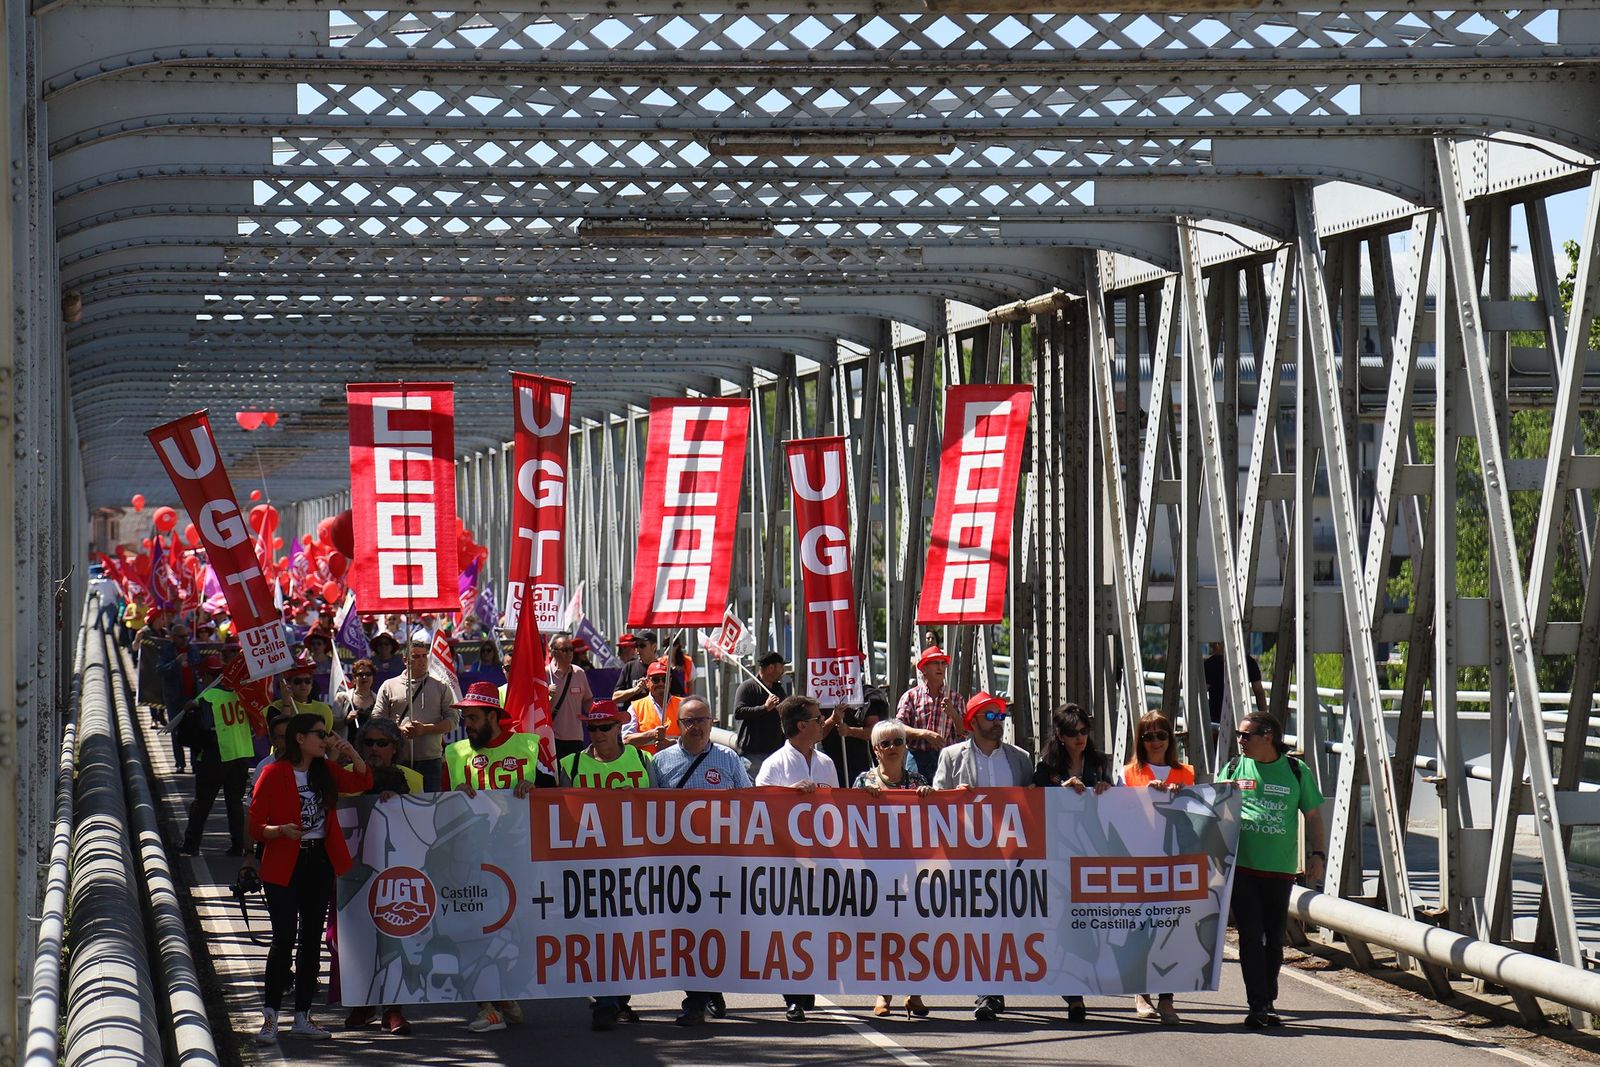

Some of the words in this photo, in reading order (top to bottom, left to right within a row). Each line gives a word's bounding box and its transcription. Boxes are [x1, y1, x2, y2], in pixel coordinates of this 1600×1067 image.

[372, 396, 438, 598] CCOO
[517, 387, 565, 577] UGT
[652, 406, 728, 612] CCOO
[937, 401, 1012, 614] CCOO
[158, 425, 260, 618] UGT
[788, 450, 849, 649] UGT
[811, 659, 854, 677] UGT
[815, 689, 823, 699] y
[548, 801, 607, 849] LA
[622, 801, 776, 848] LUCHA
[787, 795, 1028, 849] CONTINÚA
[374, 877, 426, 904] UGT
[440, 884, 488, 900] Castilla
[563, 864, 702, 919] DERECHOS
[740, 866, 879, 917] IGUALDAD
[914, 858, 1048, 919] COHESIÓN
[1080, 863, 1199, 894] CCOO
[441, 903, 450, 917] y
[453, 897, 485, 912] León
[1071, 905, 1142, 917] comisiones
[1145, 904, 1192, 917] obreras
[1071, 918, 1087, 929] de
[1090, 918, 1137, 929] Castilla
[1140, 920, 1147, 932] y
[1149, 917, 1180, 928] León
[536, 928, 727, 985] PRIMERO
[740, 930, 815, 981] LAS
[827, 932, 1048, 983] PERSONAS
